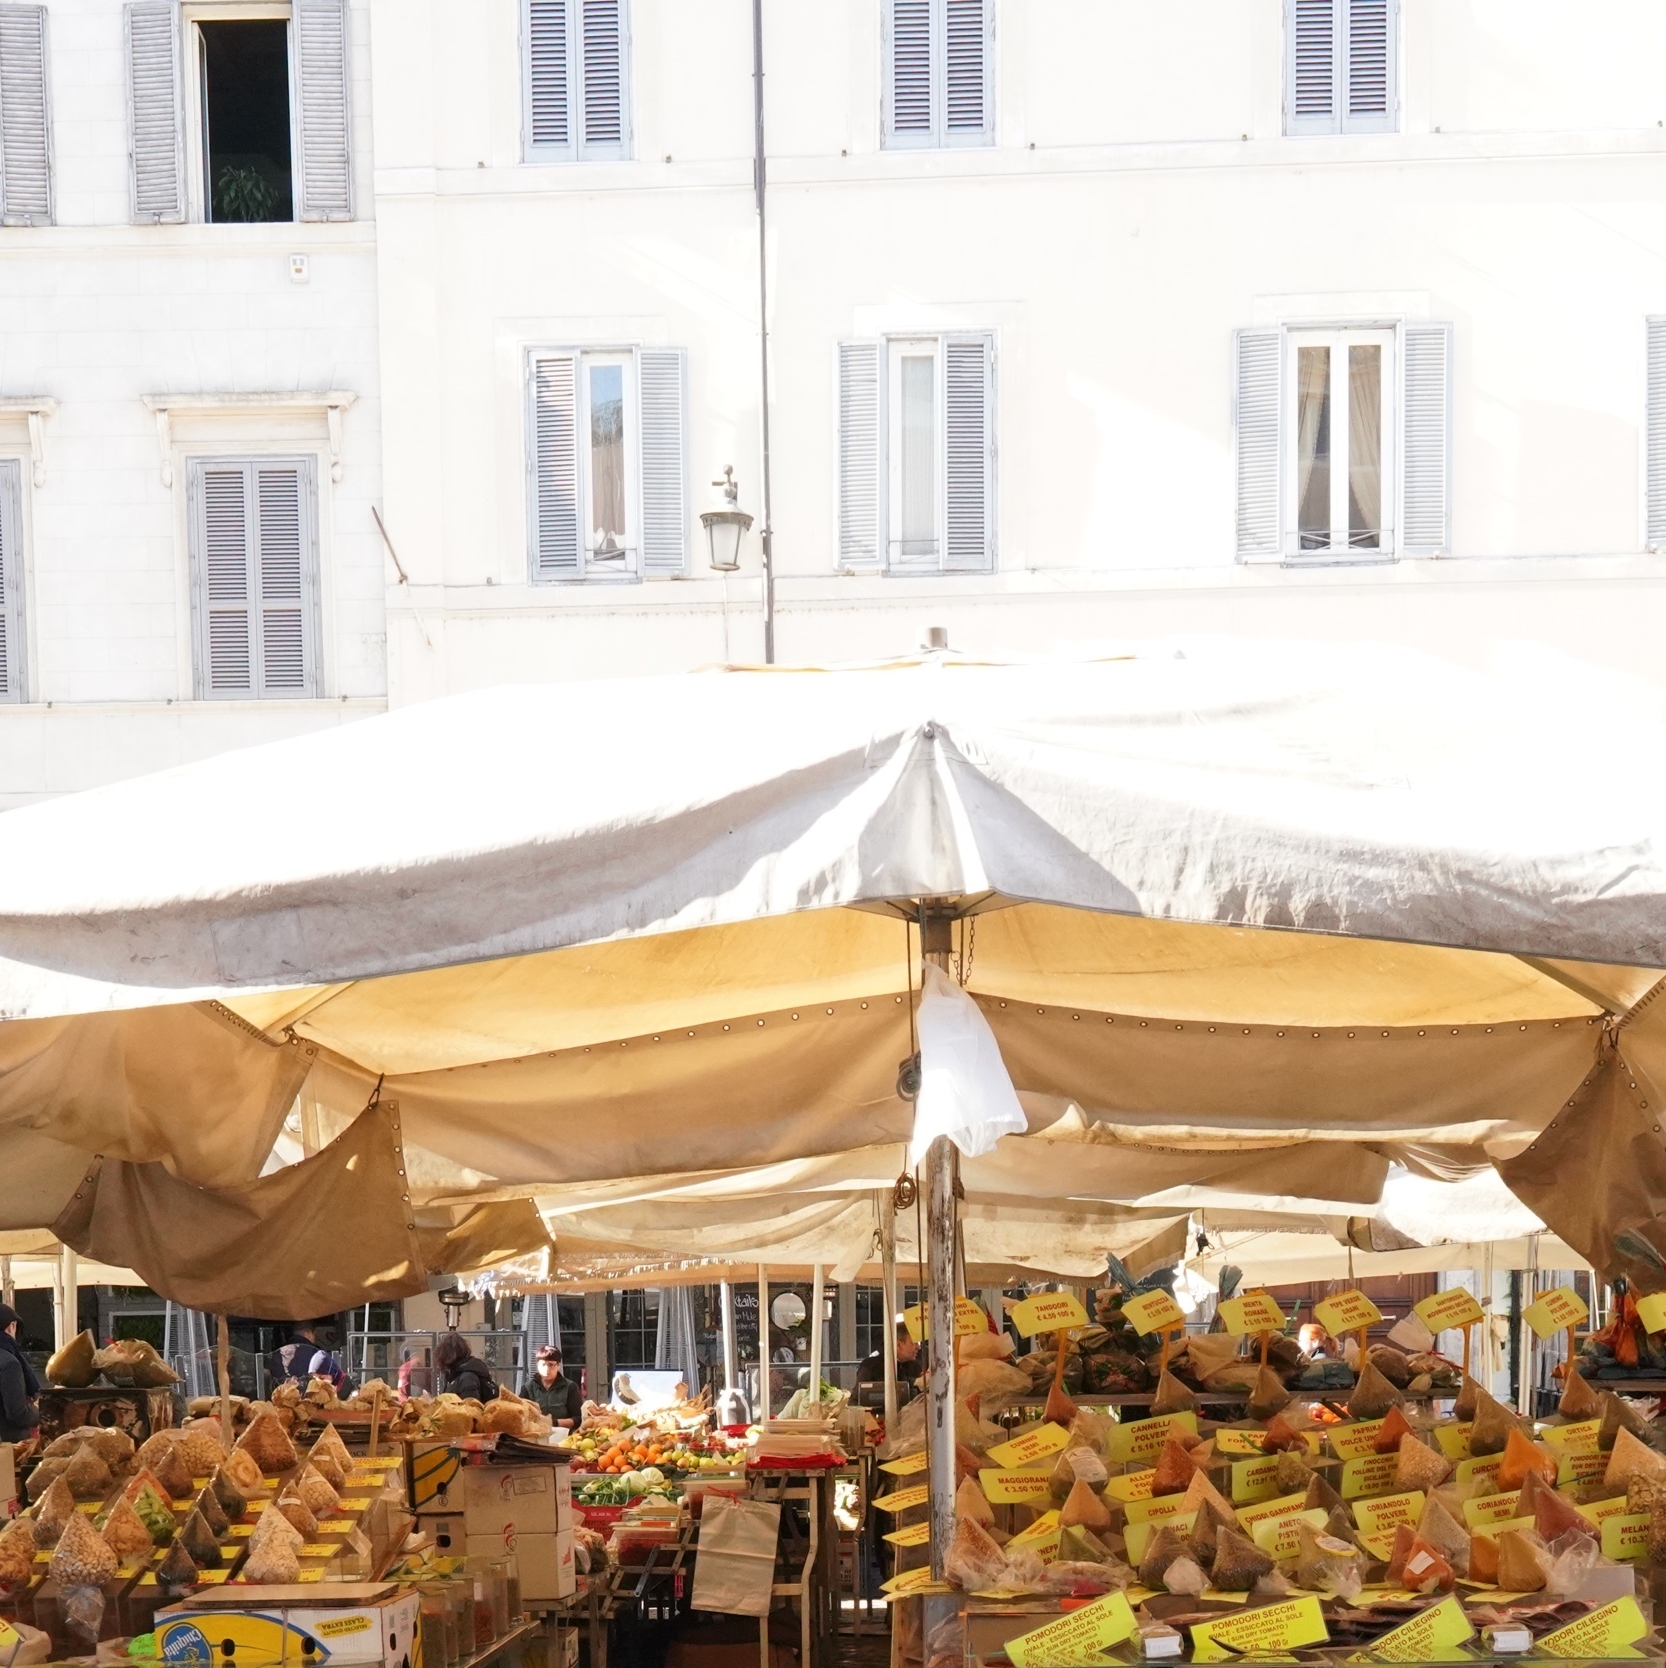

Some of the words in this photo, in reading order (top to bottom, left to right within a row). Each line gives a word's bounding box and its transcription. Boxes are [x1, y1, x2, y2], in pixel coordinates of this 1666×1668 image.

[1242, 1300, 1263, 1308] MENTA
[1545, 1294, 1563, 1307] CUMINO
[1035, 1301, 1068, 1312] TANDOORI
[1342, 1305, 1359, 1314] GRANI
[1550, 1302, 1570, 1315] POLVERE
[1566, 1426, 1592, 1435] ORTICA
[1010, 1434, 1038, 1449] CUMINO
[1022, 1442, 1040, 1452] SEMI
[1340, 1437, 1365, 1447] DOLCE
[1137, 1443, 1154, 1452] 5.16
[1352, 1466, 1375, 1476] POLLINE
[1148, 1505, 1177, 1516] CIPOLLA
[1367, 1498, 1410, 1512] CORIANDOLO
[1245, 1511, 1268, 1523] CHIODI
[1376, 1509, 1407, 1520] POLVERE
[1494, 1509, 1511, 1517] SEMI
[1278, 1519, 1301, 1529] ANETO
[1280, 1541, 1296, 1551] 7.50
[348, 1617, 365, 1625] CLASS
[1212, 1613, 1260, 1631] POMODORI
[1263, 1604, 1296, 1618] SECCHI
[1401, 1608, 1442, 1636] CILIEGINO
[1576, 1605, 1618, 1631] CILIEGINO
[321, 1621, 347, 1630] EXTRA
[1025, 1619, 1071, 1645] POMODORI
[1072, 1604, 1105, 1624] SECCHI
[1208, 1630, 1231, 1640] OVALE
[1236, 1620, 1274, 1634] ESSICCATO
[1285, 1612, 1304, 1620] SOLE
[1259, 1624, 1285, 1634] TOMATO
[1592, 1620, 1610, 1631] SOLE
[1023, 1642, 1045, 1657] OVALE
[1049, 1622, 1086, 1643] ESSICCATO
[1096, 1610, 1113, 1622] SOLE
[1060, 1637, 1072, 1647] DRY
[1073, 1625, 1097, 1640] TOMATO
[1418, 1624, 1434, 1637] SOLE
[163, 1628, 202, 1657] Chiquita
[1084, 1642, 1096, 1653] 100
[1268, 1639, 1281, 1649] 100
